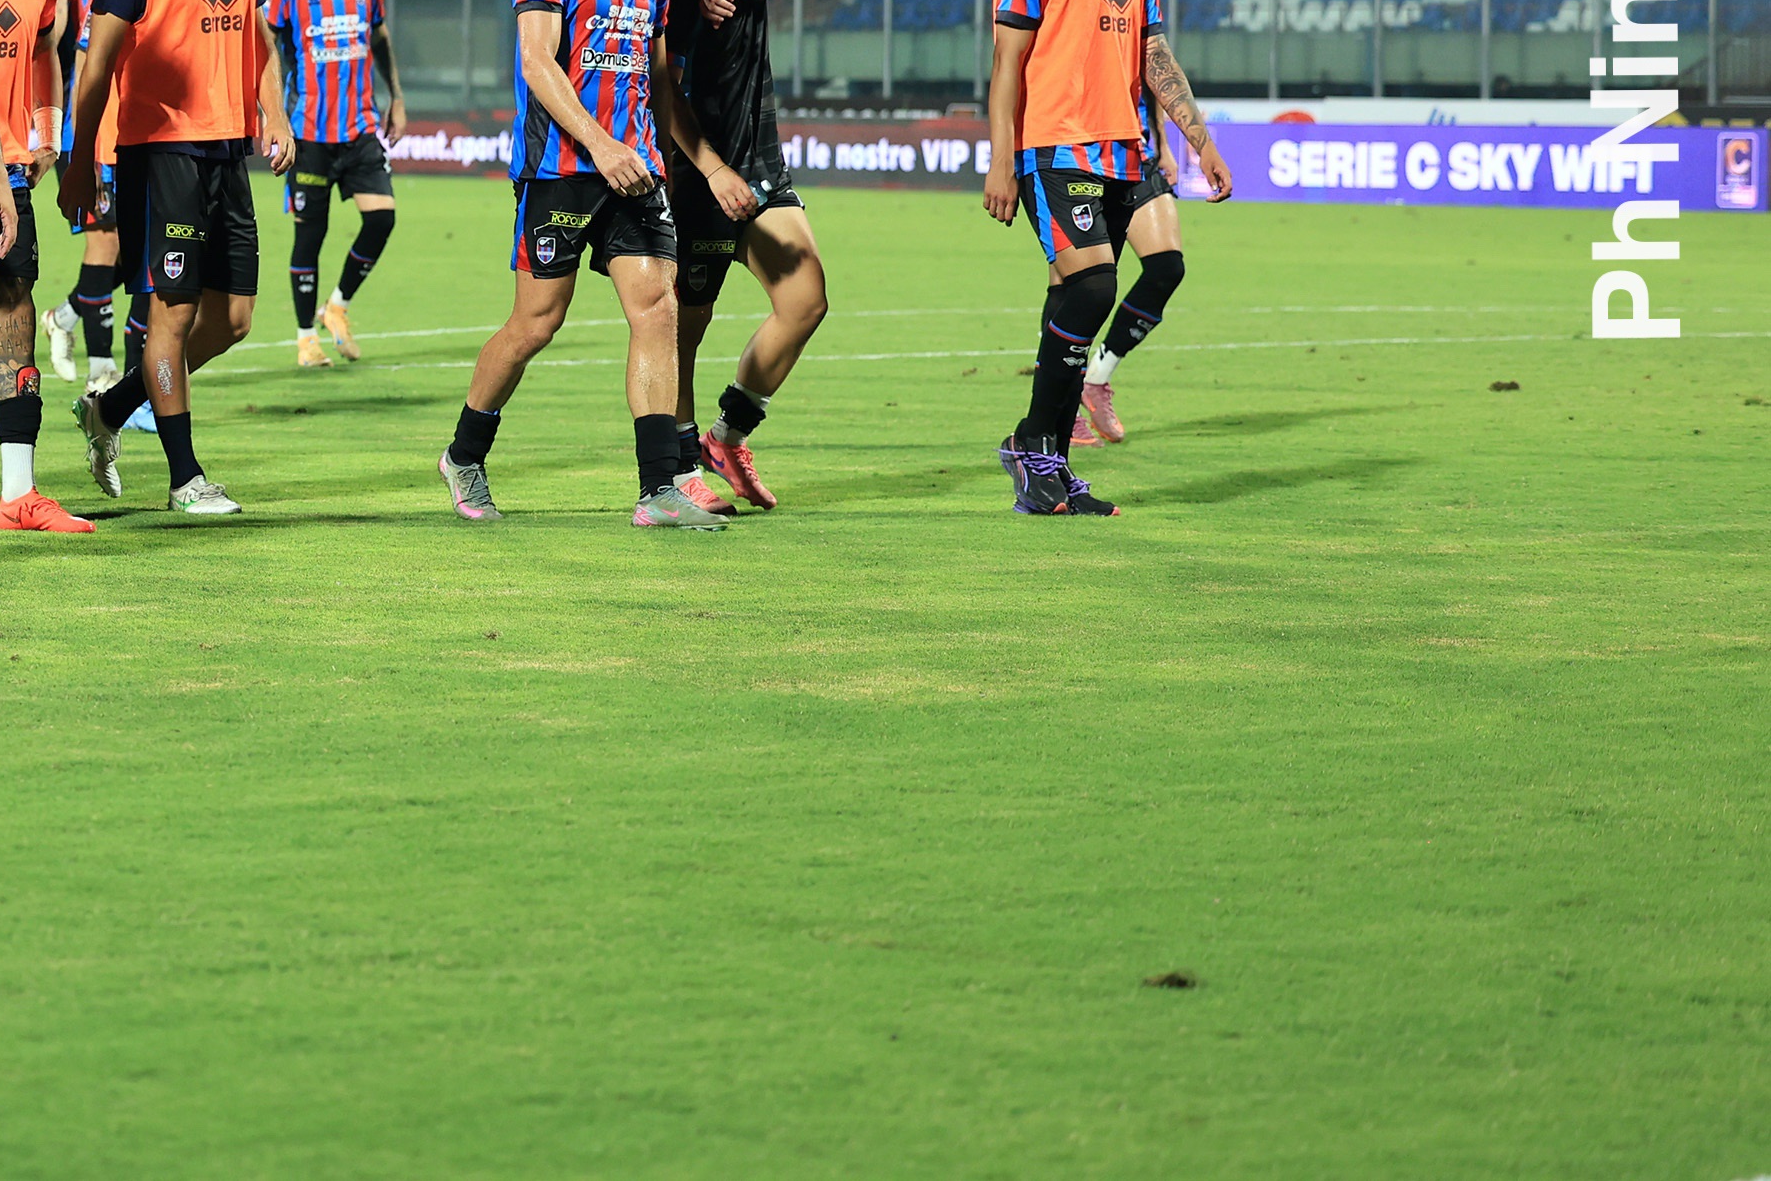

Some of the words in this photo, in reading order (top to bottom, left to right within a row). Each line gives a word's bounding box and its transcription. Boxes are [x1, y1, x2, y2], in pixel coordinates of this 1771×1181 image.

[806, 135, 832, 171] le
[835, 136, 918, 172] nostre
[921, 138, 971, 173] VIP
[1268, 139, 1399, 189] SERIE
[1405, 141, 1441, 190] C
[1447, 141, 1543, 192] SKY
